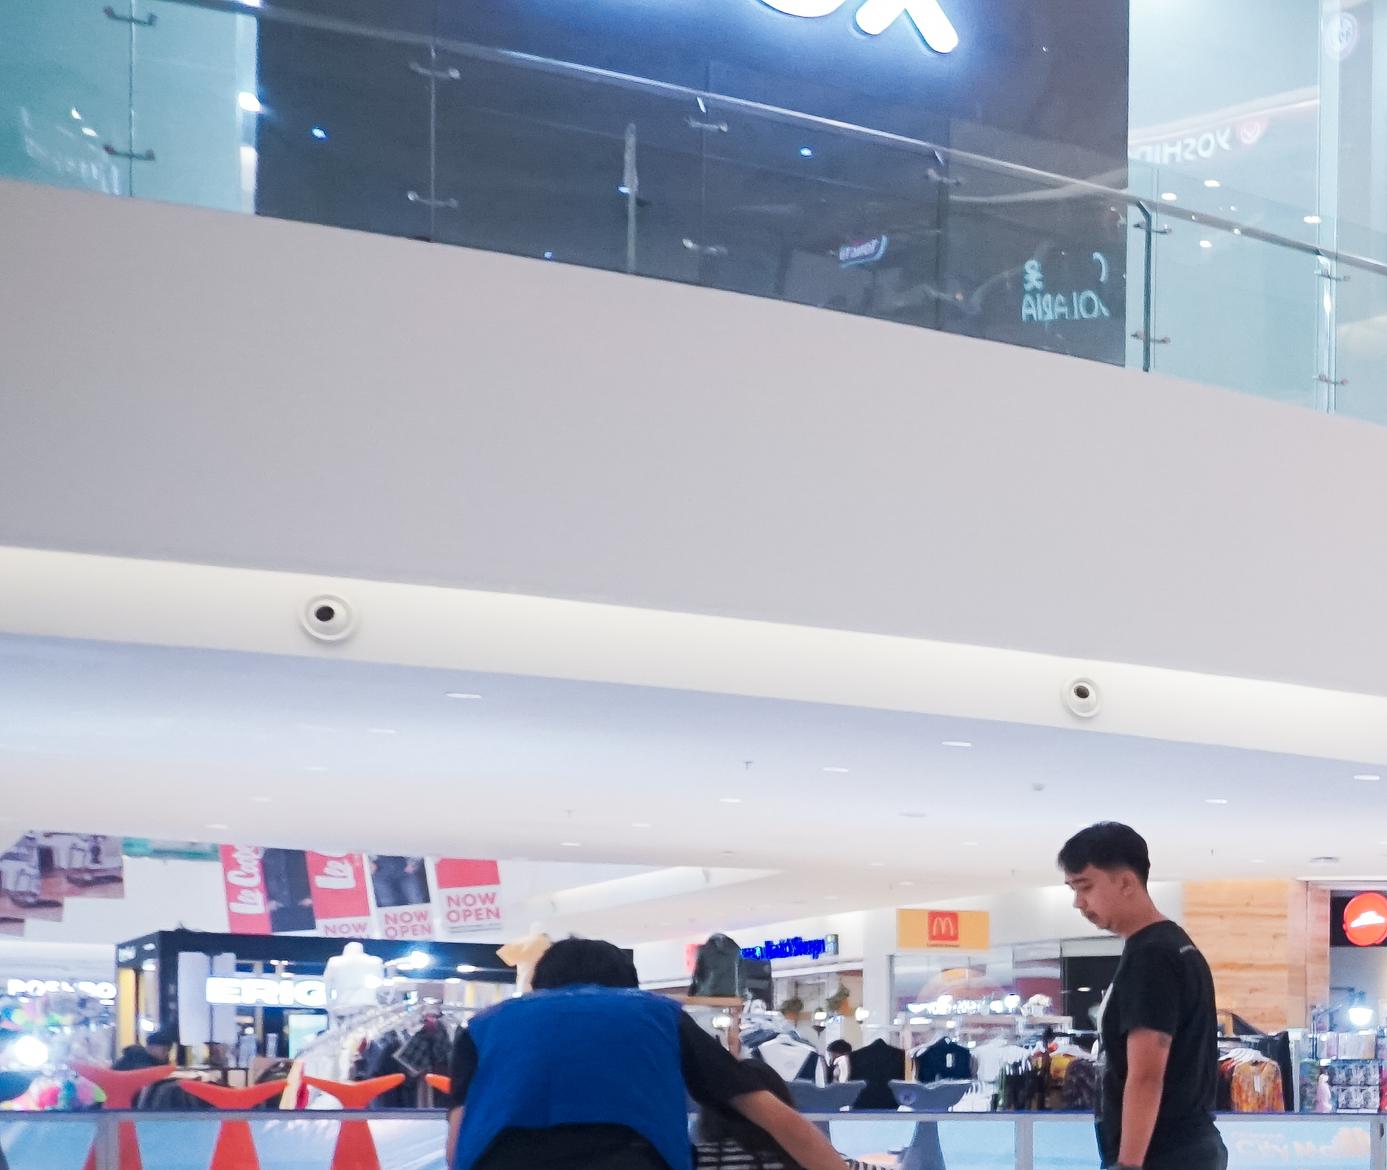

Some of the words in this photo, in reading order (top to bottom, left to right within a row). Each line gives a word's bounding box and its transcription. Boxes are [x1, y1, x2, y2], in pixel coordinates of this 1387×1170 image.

[446, 892, 496, 907] NOW
[384, 911, 429, 925] NOW
[447, 907, 501, 922] OPEN
[323, 922, 367, 935] NOW
[385, 924, 433, 939] OPEN
[206, 977, 330, 1007] ERIG
